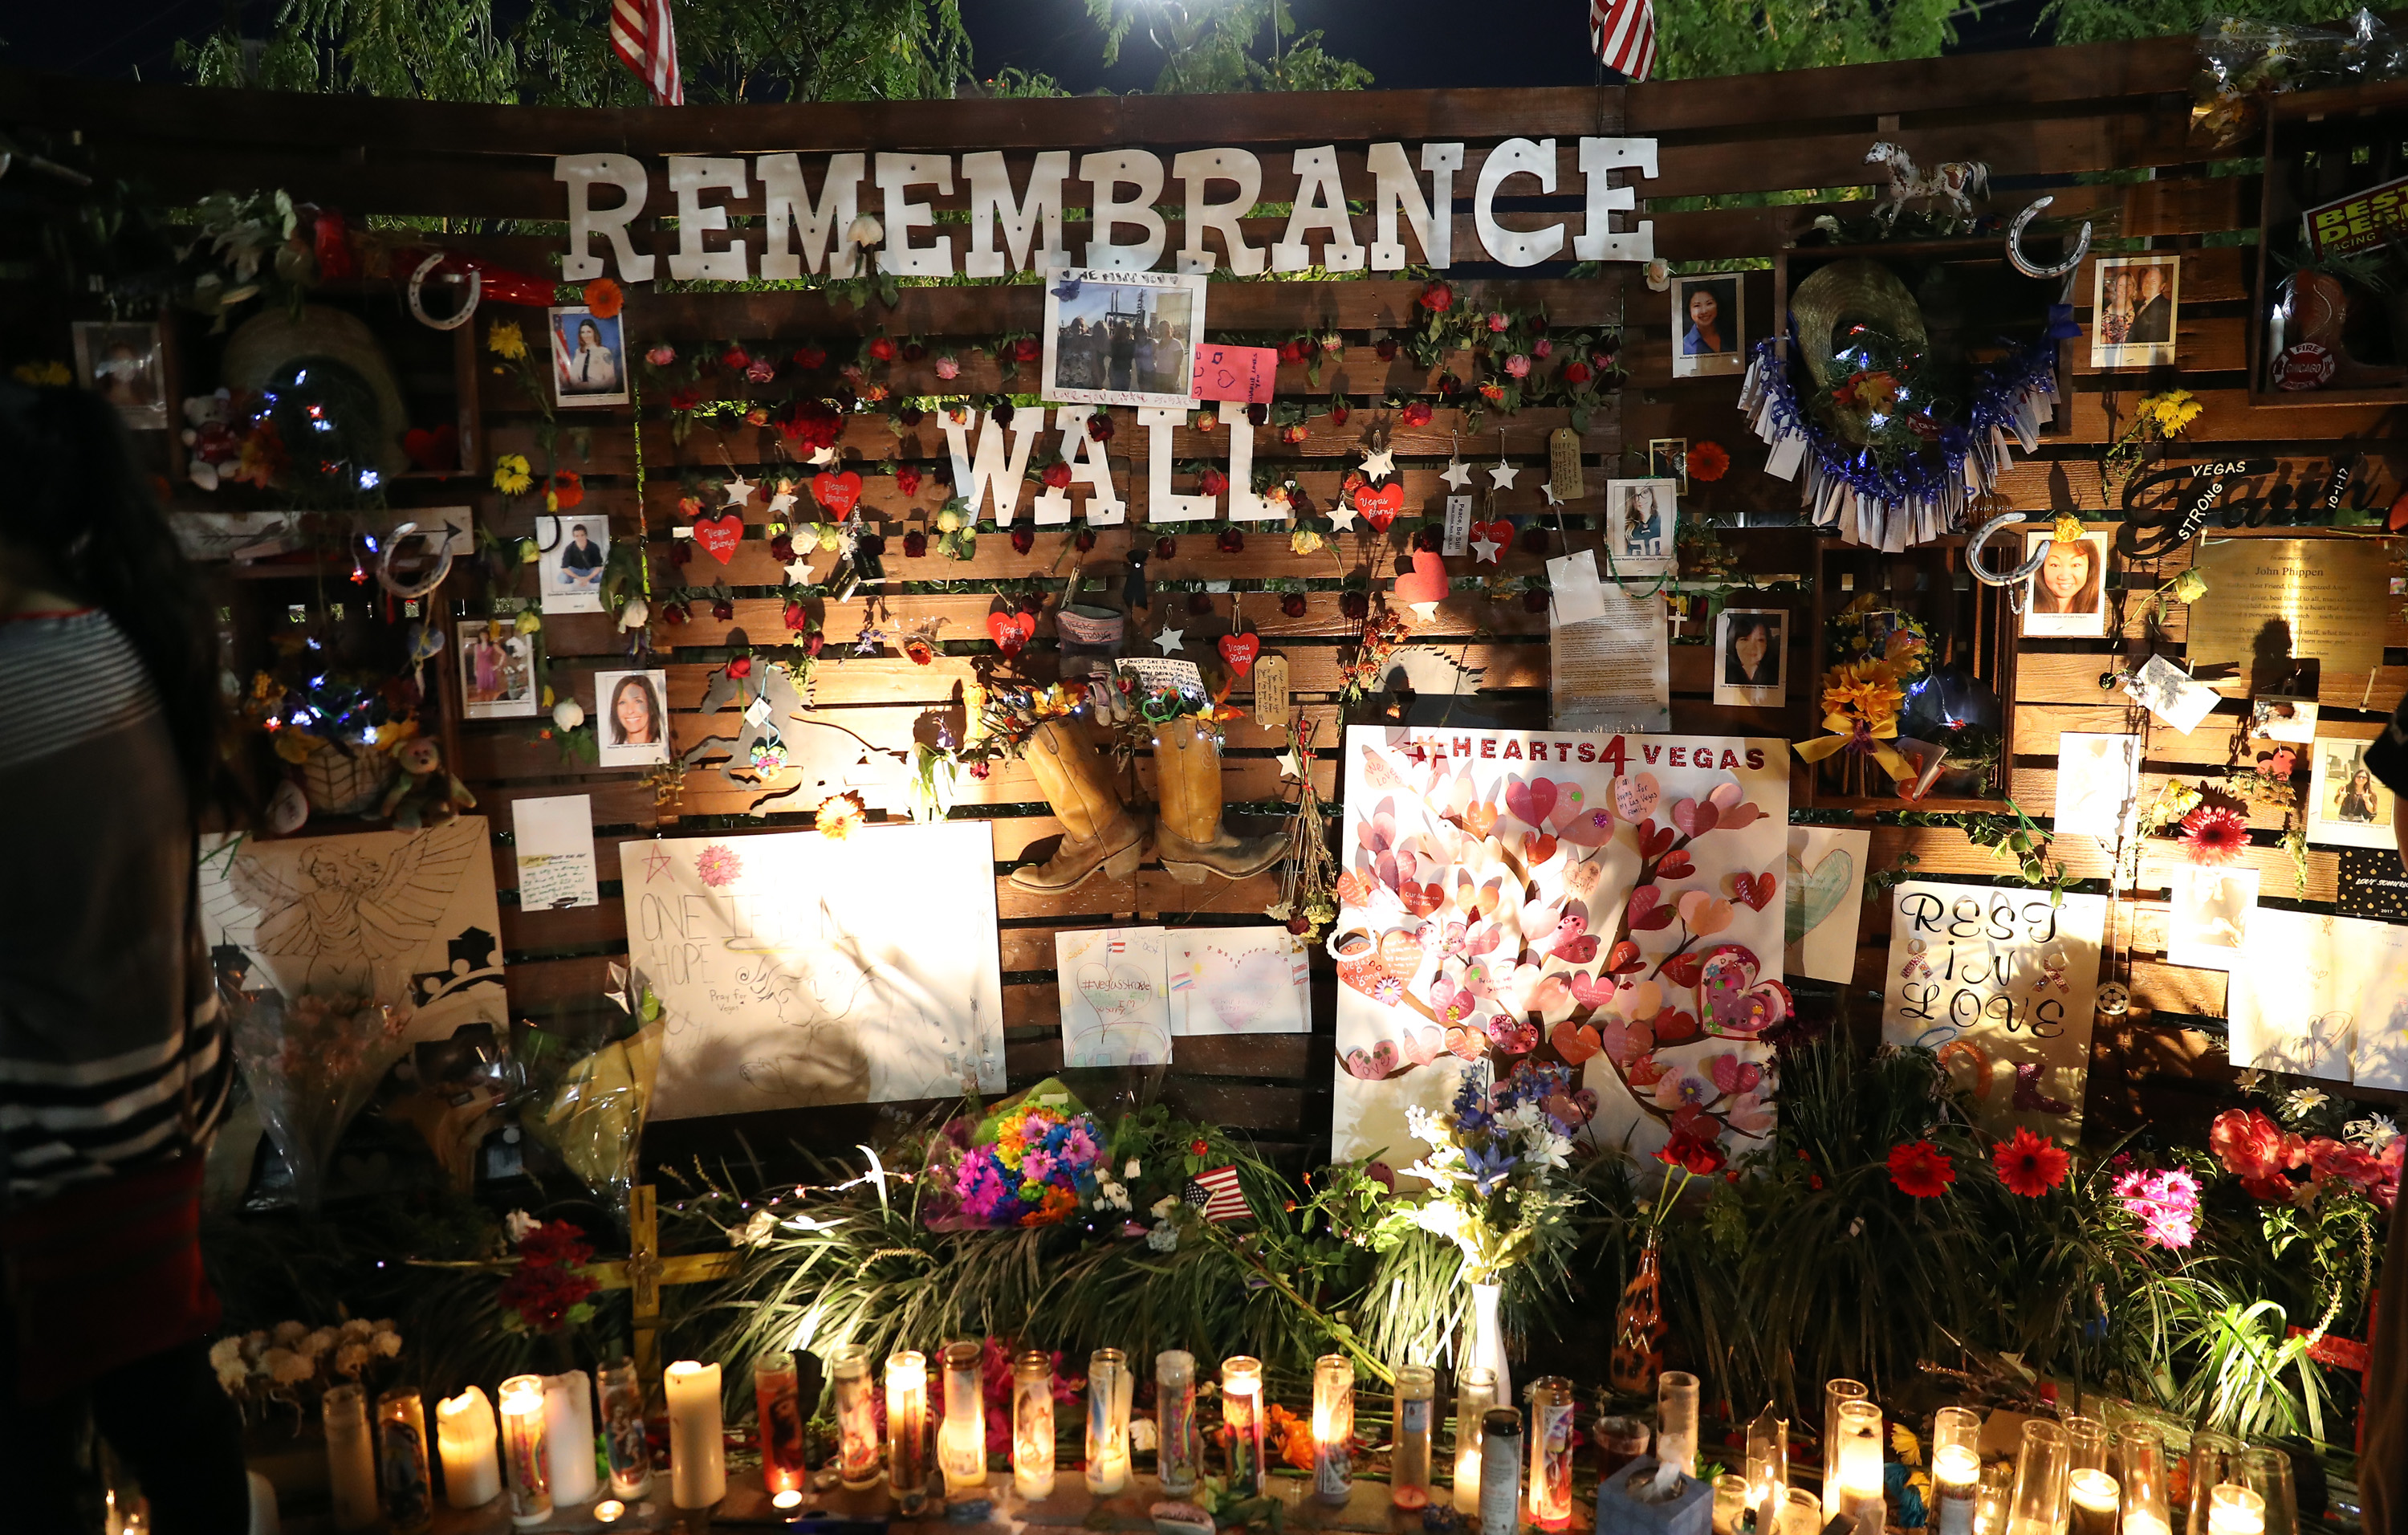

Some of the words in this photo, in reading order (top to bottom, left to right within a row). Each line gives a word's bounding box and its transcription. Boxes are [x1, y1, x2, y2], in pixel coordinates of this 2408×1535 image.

[554, 136, 1659, 283] REMEMBRANCE
[2295, 344, 2321, 353] FIRE
[2285, 363, 2321, 374] CHICAGO
[936, 404, 1290, 527] WALL
[2190, 460, 2246, 477] VEGAS
[824, 480, 849, 492] Vegas
[2328, 467, 2349, 510] 10-1-17
[1360, 497, 1389, 509] Vegas
[2178, 483, 2223, 541] STRONG
[704, 527, 731, 539] Vegas
[1456, 527, 1462, 535] Be
[2255, 566, 2279, 576] John
[2282, 567, 2324, 578] Phippen
[1077, 631, 1112, 641] STRONG
[1226, 643, 1250, 655] Vegas
[1366, 761, 1384, 775] We
[1641, 792, 1658, 803] Vegas
[641, 893, 707, 941] ONE
[1900, 893, 2067, 943] REST
[652, 943, 715, 986] HOPE
[1342, 957, 1370, 971] Vegas
[1349, 971, 1381, 984] Strong
[710, 988, 730, 1004] Pray
[733, 990, 747, 1001] for
[716, 1003, 740, 1016] Vegas
[1900, 981, 2064, 1038] LOVE
